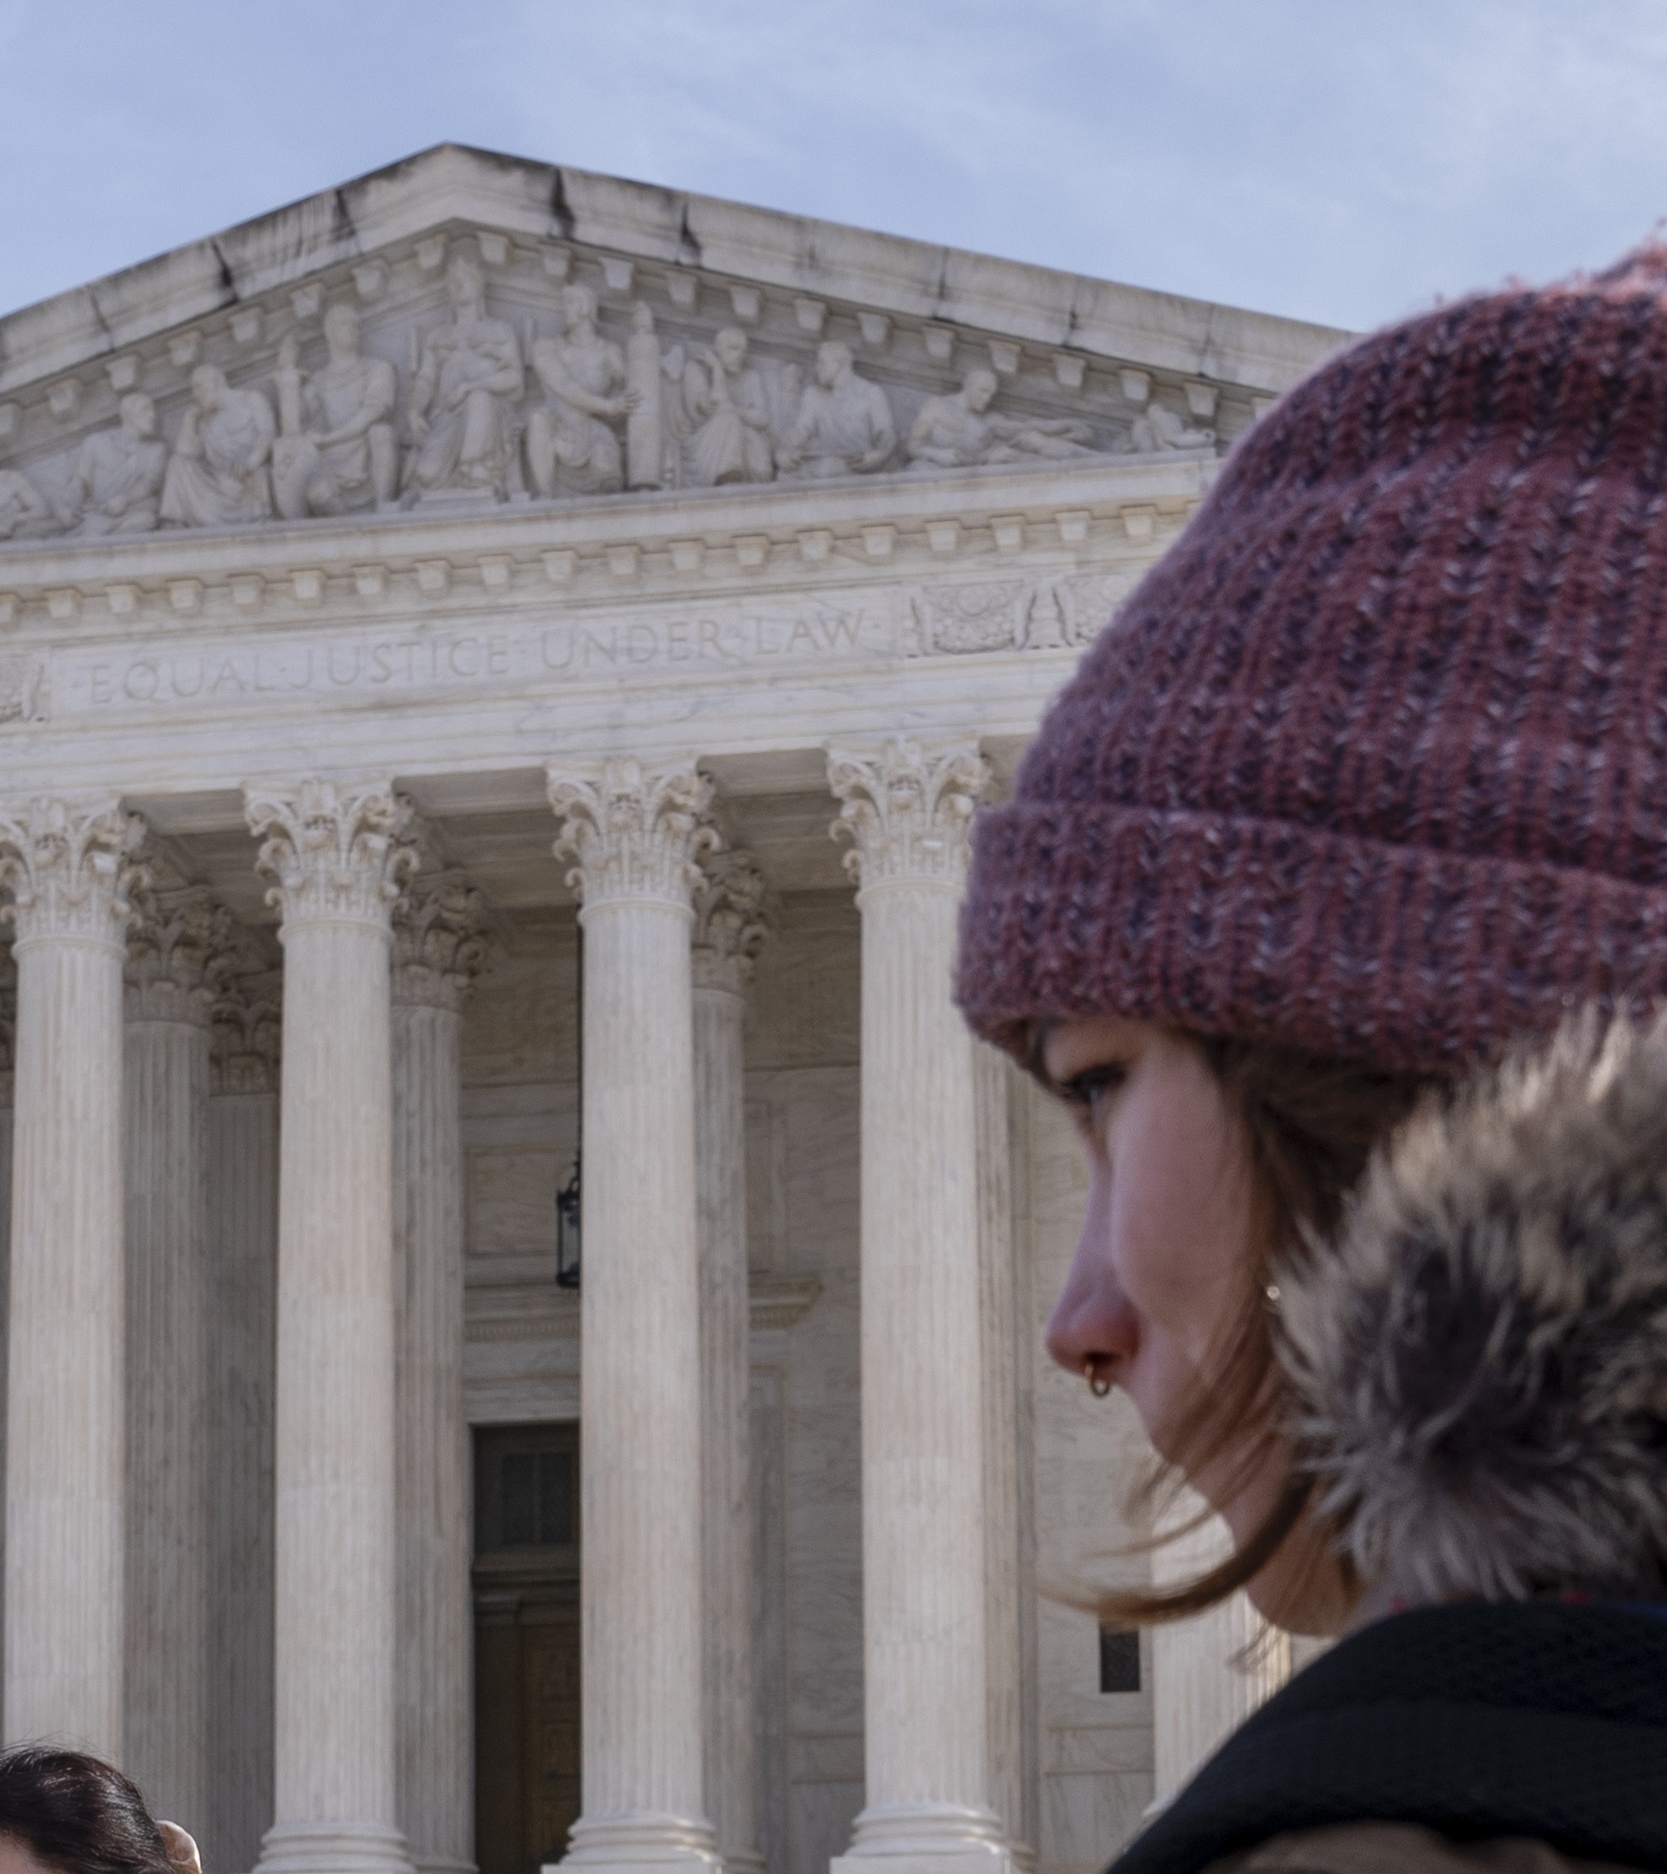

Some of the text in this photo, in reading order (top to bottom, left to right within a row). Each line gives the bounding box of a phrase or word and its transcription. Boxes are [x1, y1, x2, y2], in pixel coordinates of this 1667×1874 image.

[89, 608, 866, 705] EQUAL JUSTICE UNDER LAW
